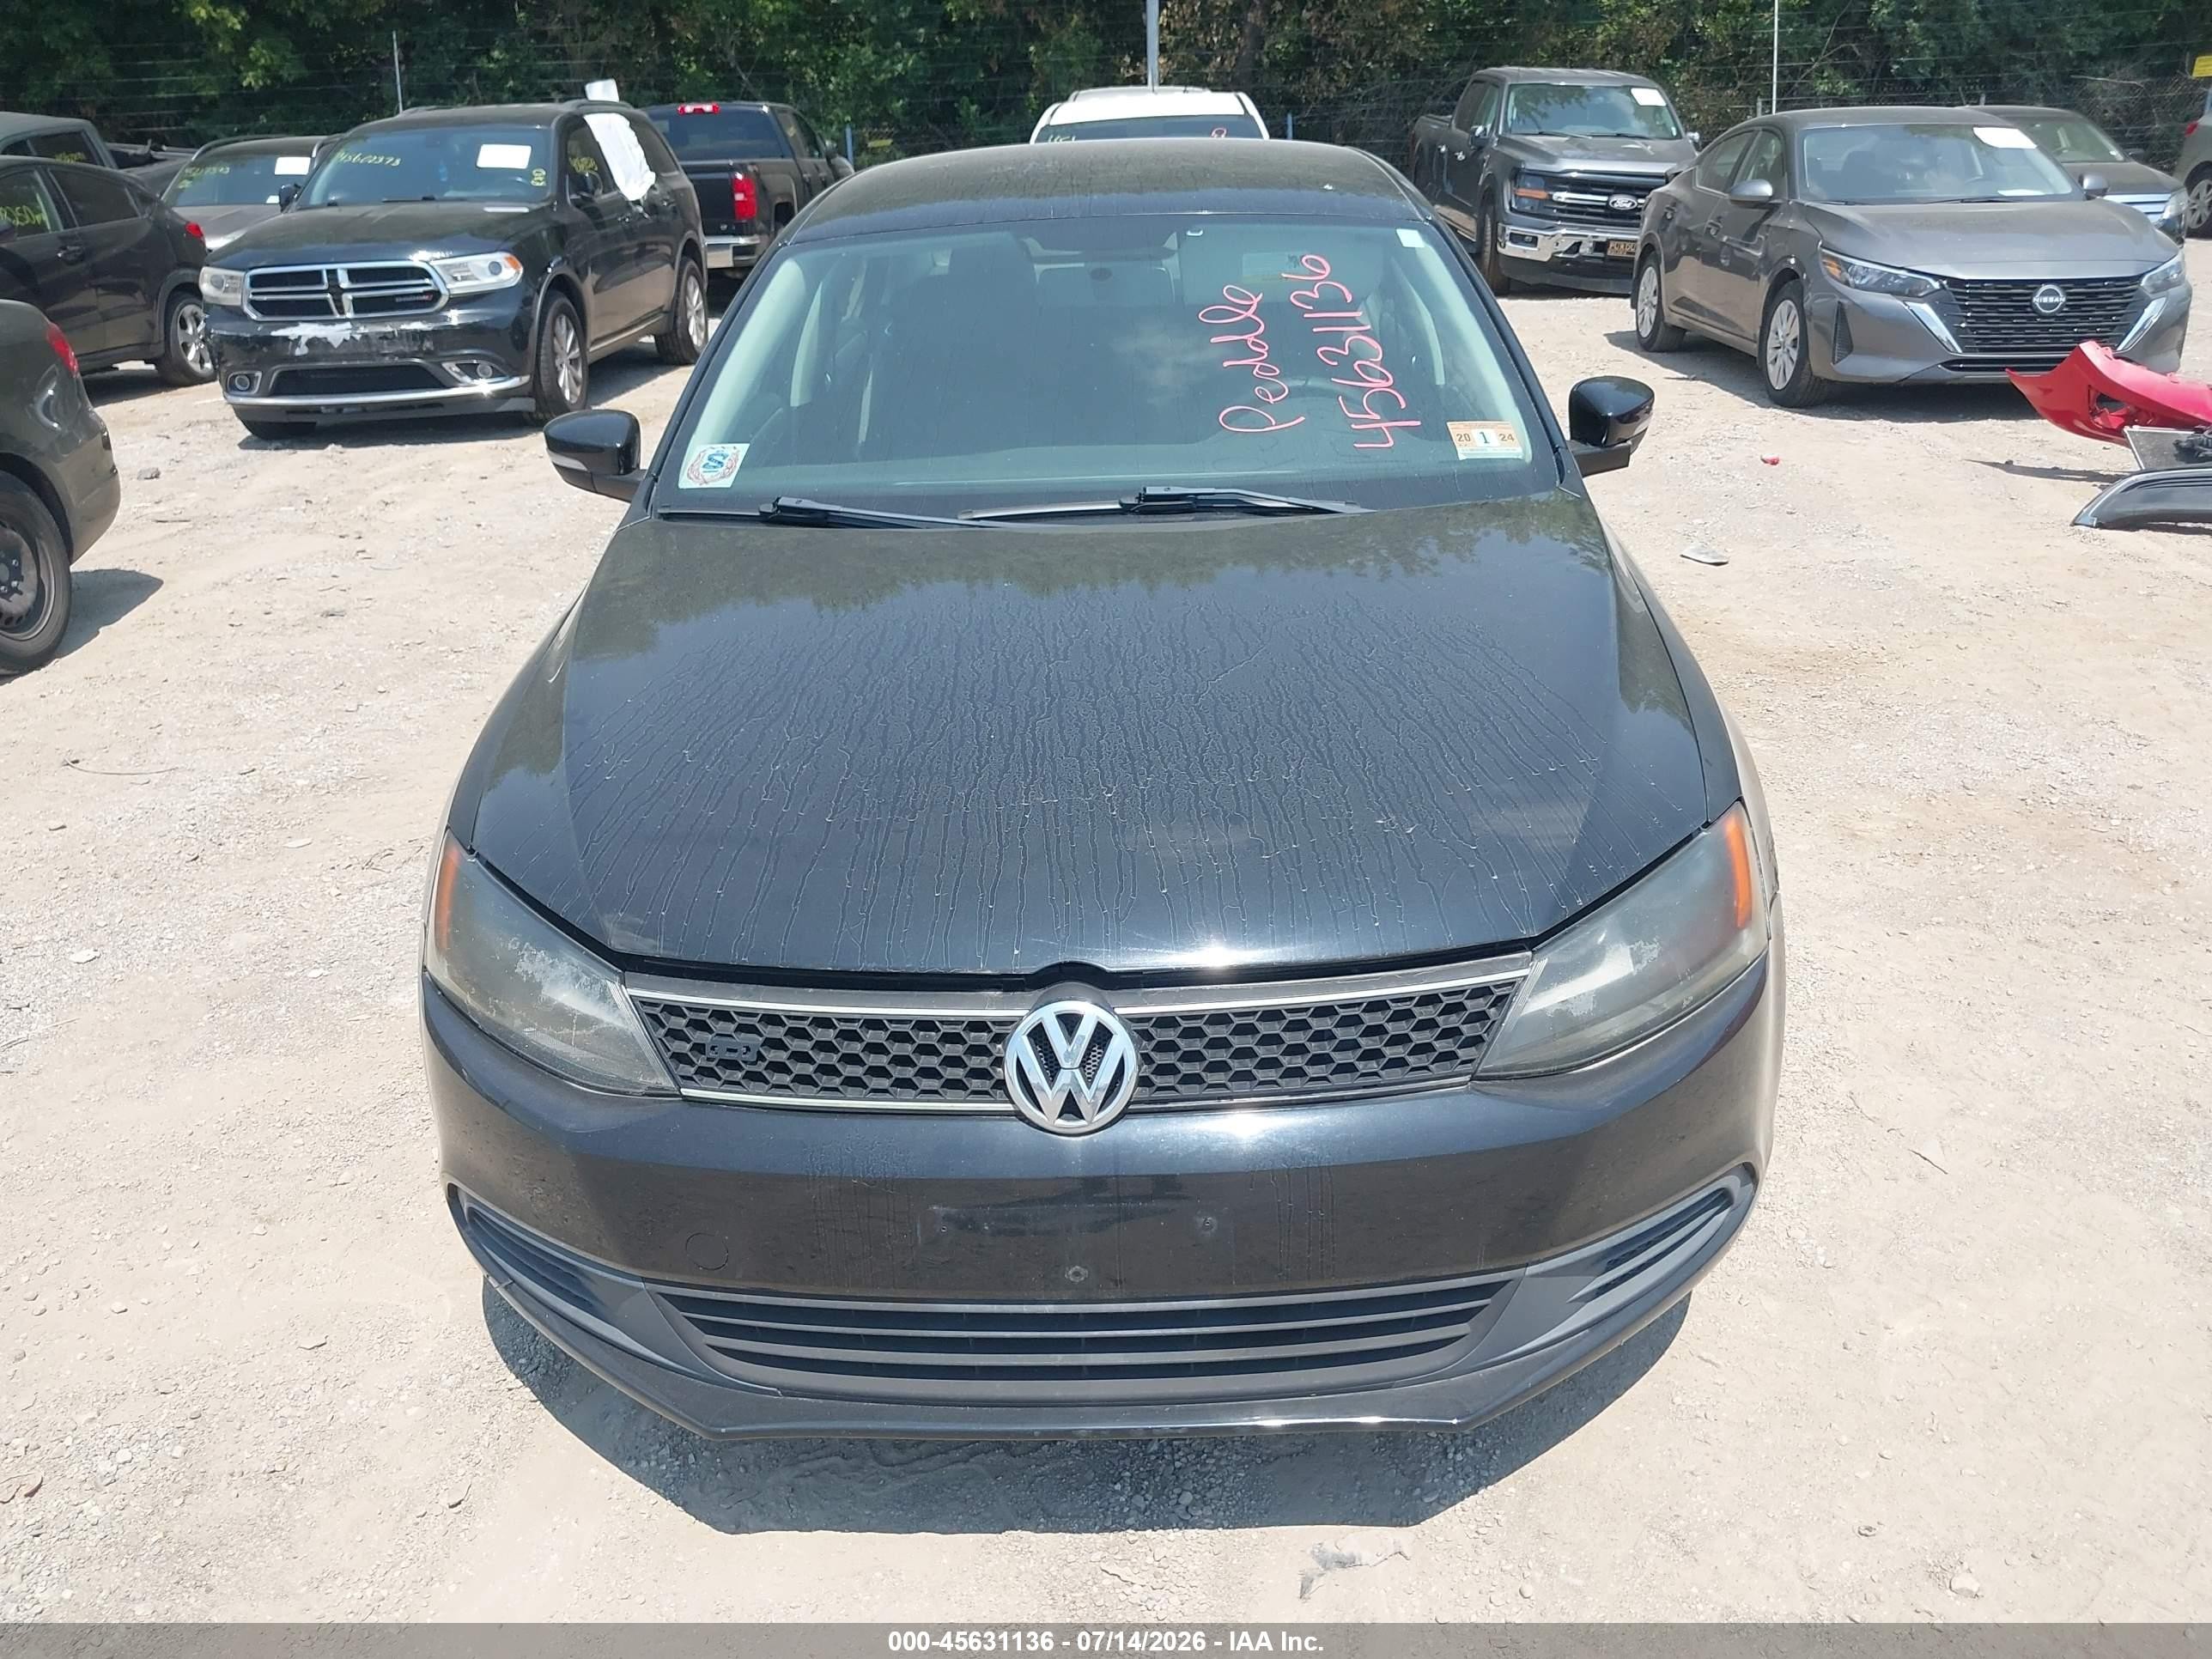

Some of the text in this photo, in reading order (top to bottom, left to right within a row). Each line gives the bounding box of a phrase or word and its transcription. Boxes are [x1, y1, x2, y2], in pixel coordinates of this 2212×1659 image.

[1199, 284, 1305, 432] Peddle
[1281, 254, 1421, 448] 45631136
[1456, 431, 1515, 444] 20 1 24
[1006, 1001, 1138, 1134] VW
